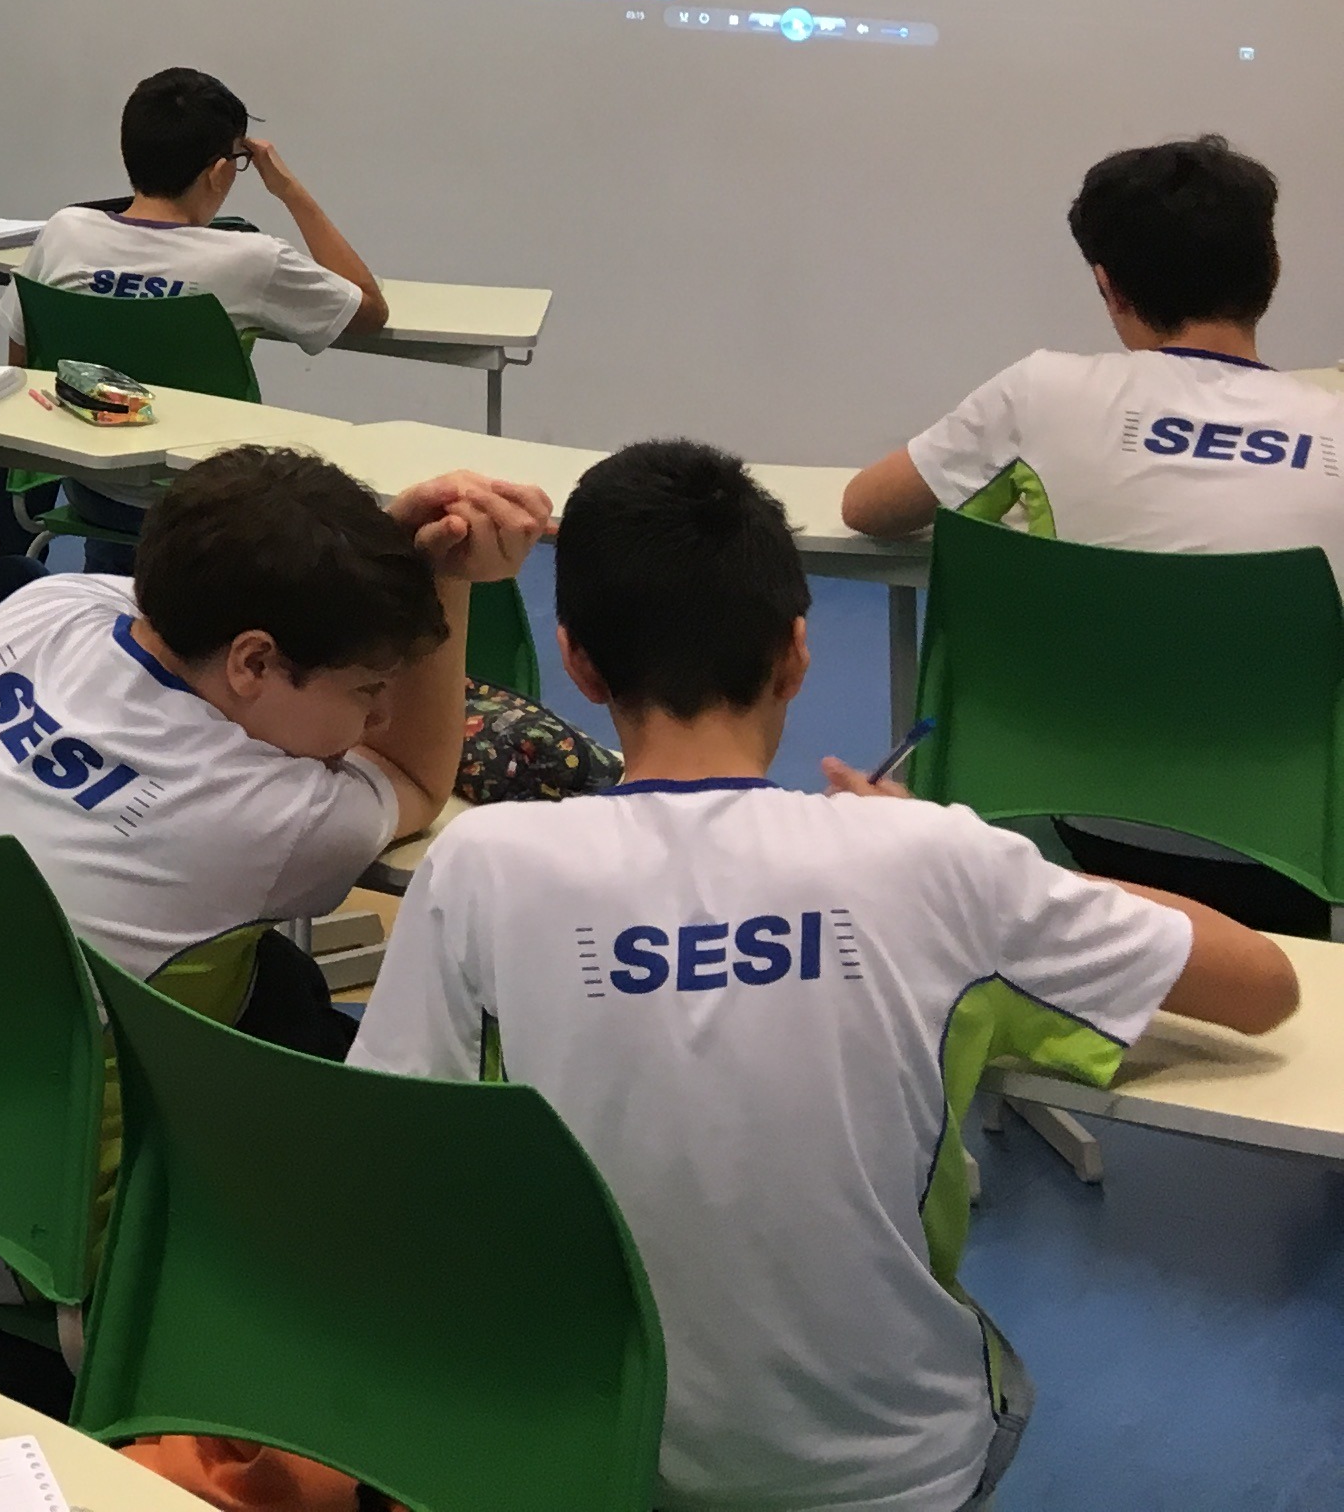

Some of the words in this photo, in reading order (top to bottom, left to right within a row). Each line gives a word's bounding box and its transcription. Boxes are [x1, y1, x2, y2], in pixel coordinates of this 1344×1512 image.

[89, 269, 184, 299] SESI
[1143, 416, 1314, 470] SESI
[609, 911, 822, 995] SESI
